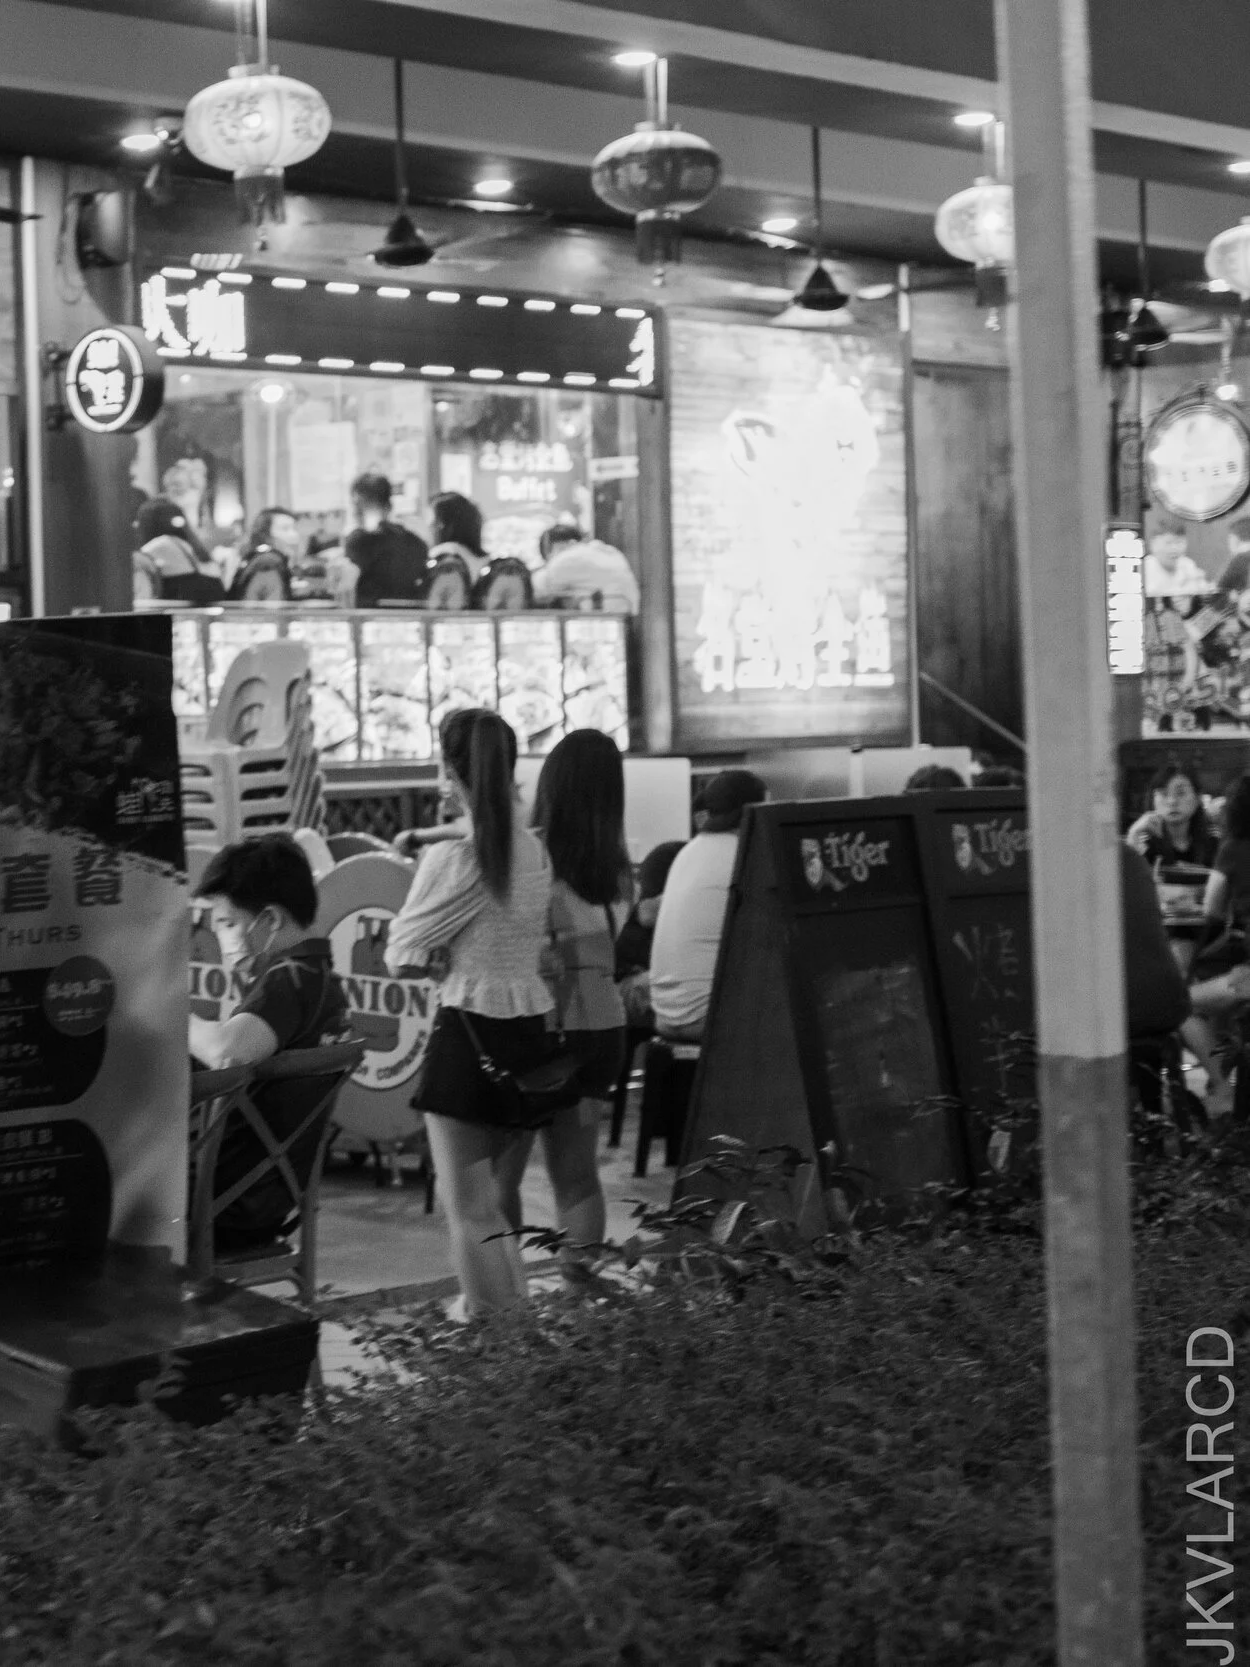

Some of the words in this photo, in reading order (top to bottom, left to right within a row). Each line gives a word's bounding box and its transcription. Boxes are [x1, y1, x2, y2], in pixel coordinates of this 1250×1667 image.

[823, 830, 890, 882] Tiger
[972, 817, 1029, 867] Tige
[345, 977, 430, 1019] NION
